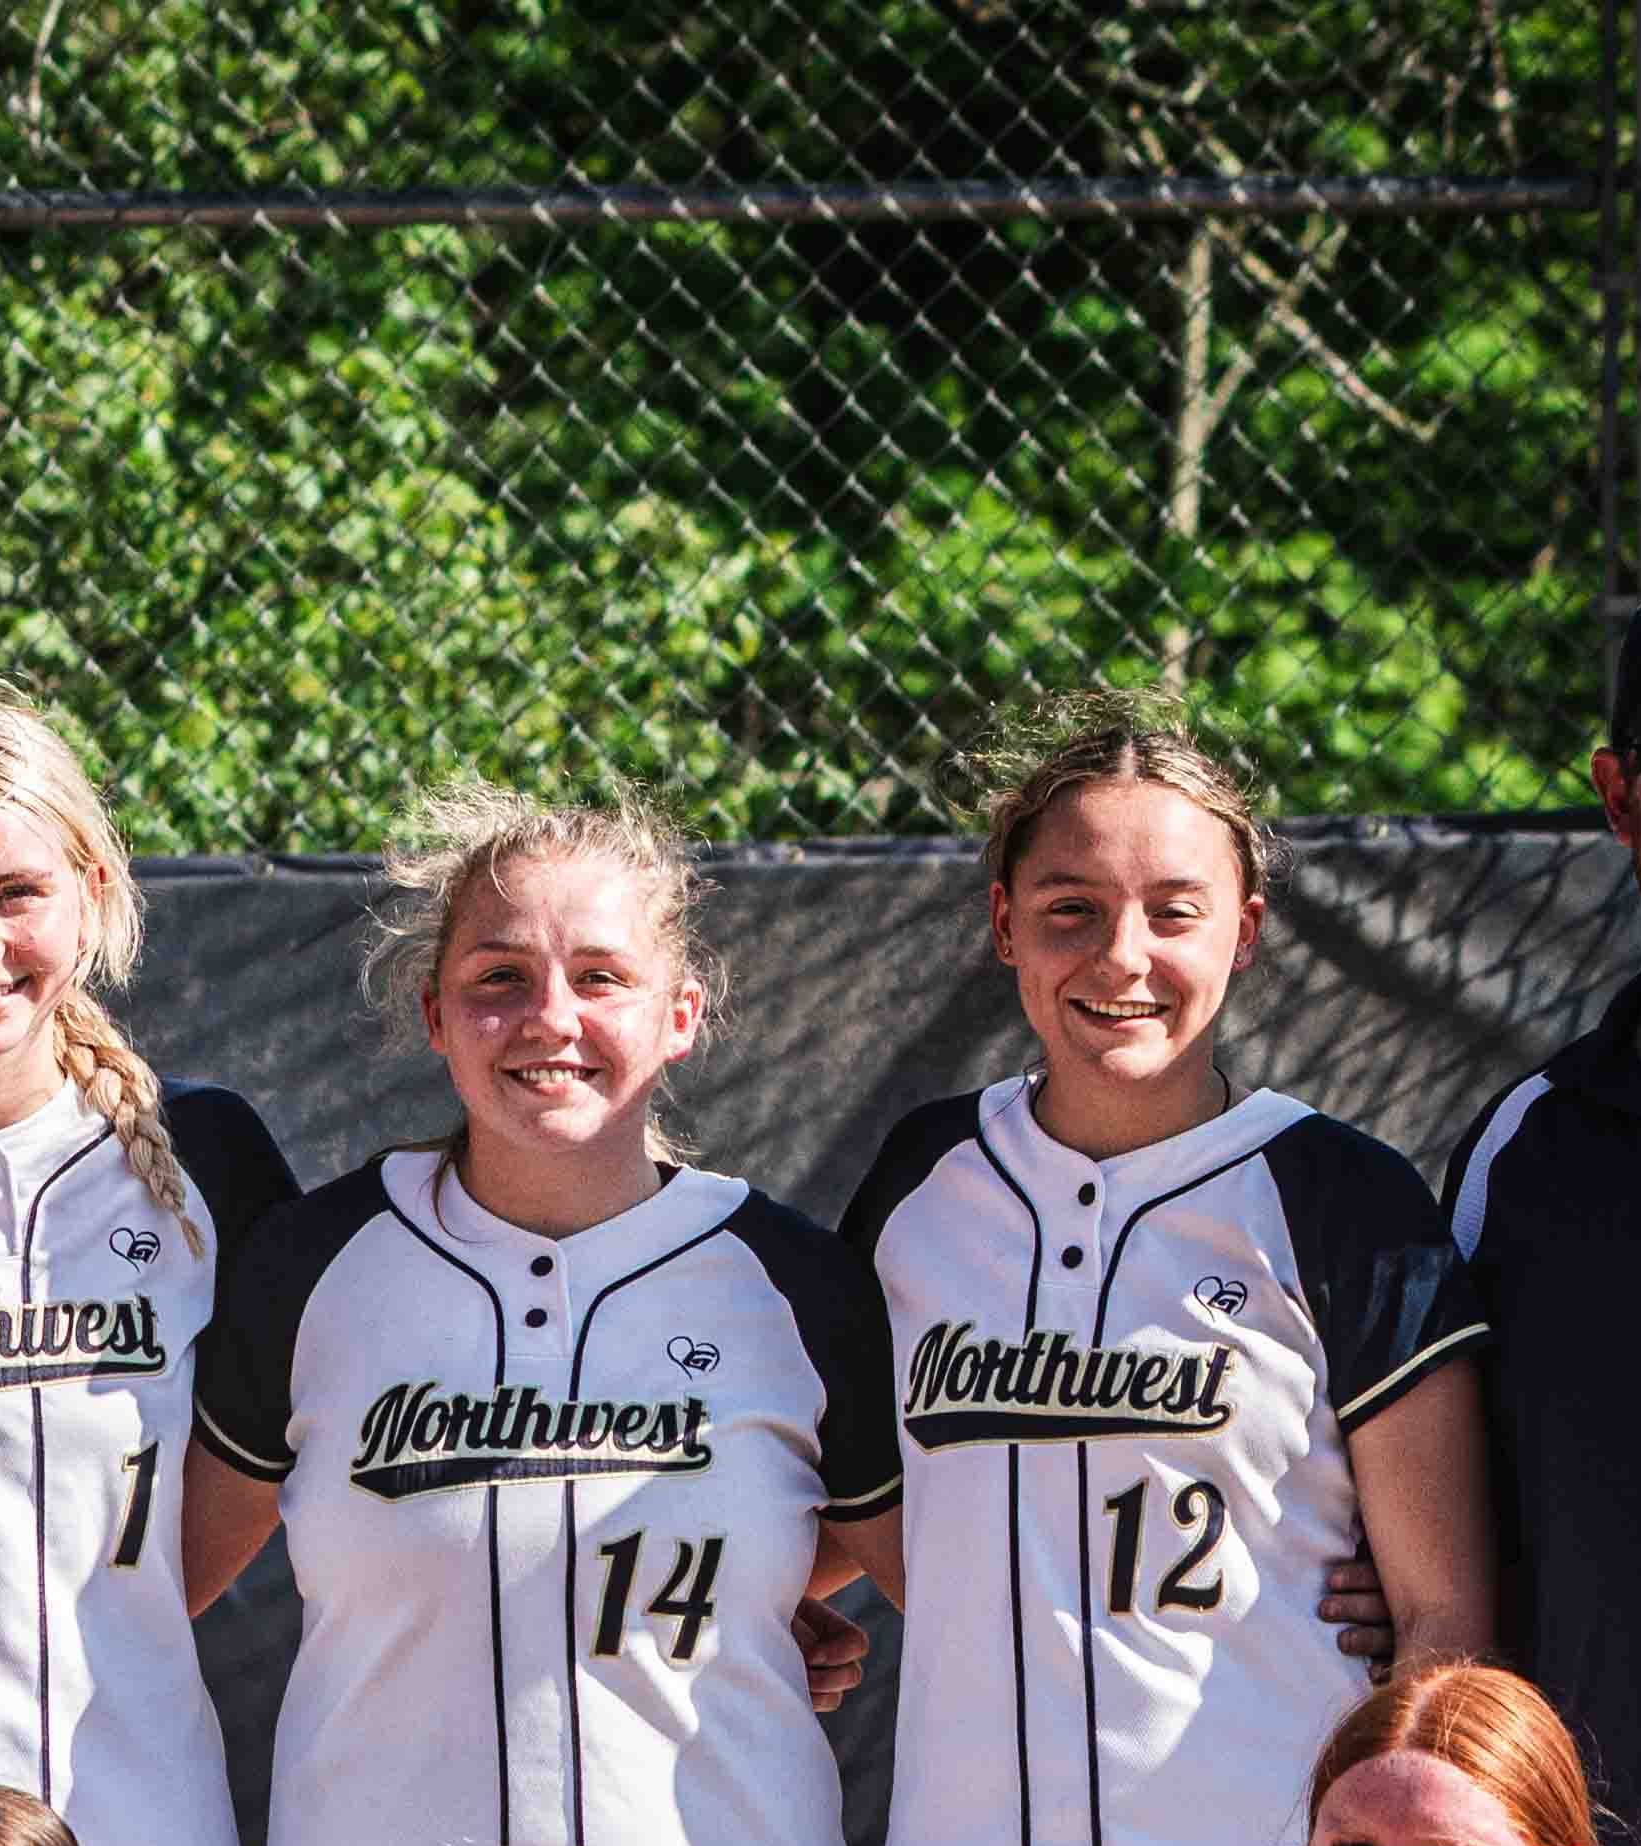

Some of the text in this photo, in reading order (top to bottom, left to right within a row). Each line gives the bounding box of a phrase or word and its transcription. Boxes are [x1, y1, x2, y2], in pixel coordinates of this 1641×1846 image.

[349, 1379, 713, 1472] Northwest
[903, 1318, 1237, 1422] Northwest
[107, 1440, 160, 1571] 1
[1101, 1475, 1230, 1618] 12
[586, 1526, 729, 1672] 14
